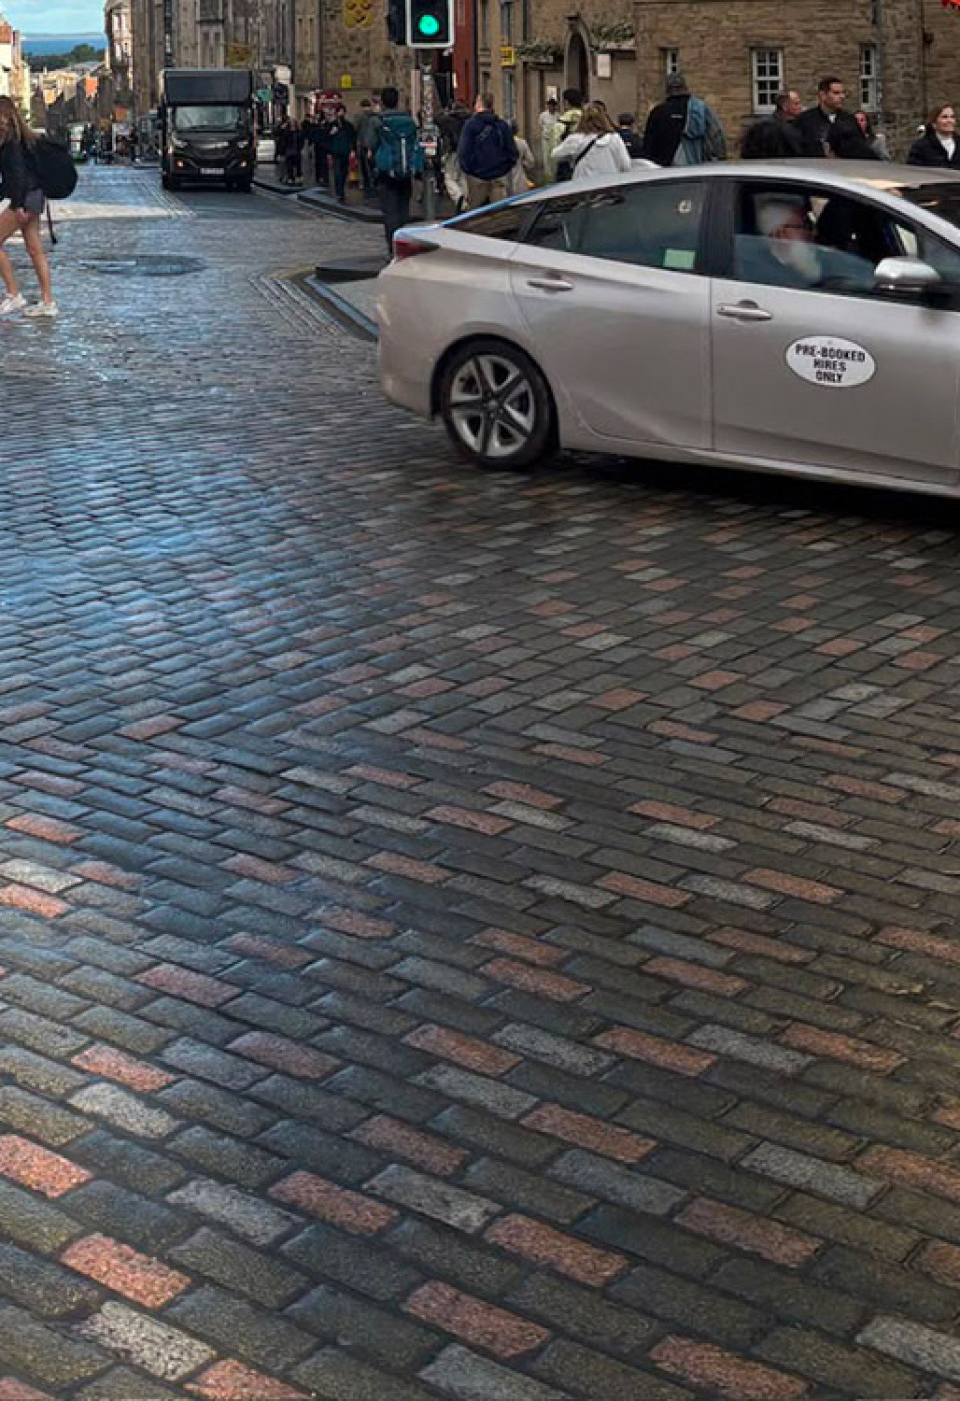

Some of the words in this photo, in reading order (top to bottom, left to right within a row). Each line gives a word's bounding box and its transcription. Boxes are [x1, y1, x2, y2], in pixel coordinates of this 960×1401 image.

[795, 343, 865, 362] PRE-BOOKED
[813, 359, 847, 373] HIRES
[815, 370, 843, 383] ONLY
